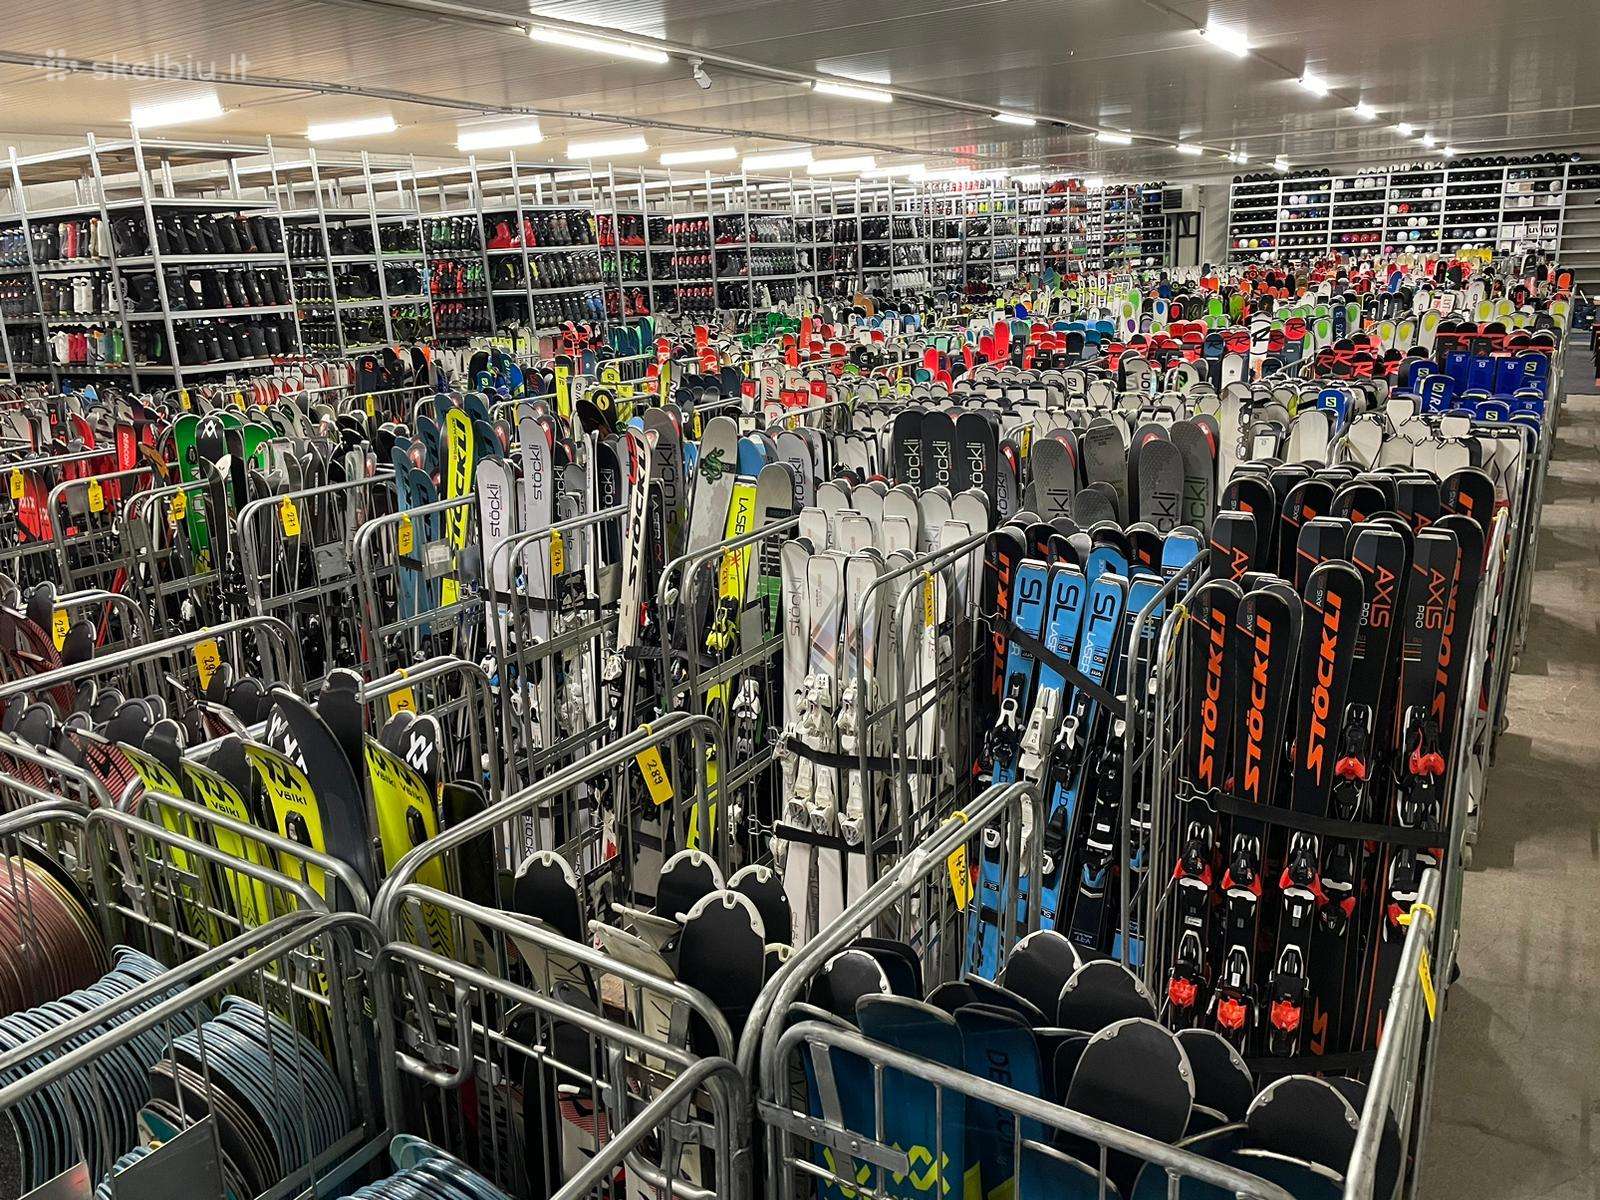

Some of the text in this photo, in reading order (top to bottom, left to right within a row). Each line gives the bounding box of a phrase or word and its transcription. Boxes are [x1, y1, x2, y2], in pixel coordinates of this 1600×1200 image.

[528, 444, 543, 500] stöckli
[487, 484, 502, 538] stöckli
[628, 437, 645, 587] STÖCKLI
[1017, 577, 1042, 616] SL
[1053, 583, 1079, 622] SL
[1089, 592, 1115, 632] SL
[1315, 589, 1324, 608] AXIS
[1360, 565, 1396, 628] AXIS PRO
[1415, 568, 1446, 630] AXIS PRO
[1080, 632, 1097, 674] LASER
[1199, 608, 1226, 790] STÖCKLI
[1244, 615, 1272, 803] STÖCKLI
[1307, 590, 1342, 787] STÖCKLI
[210, 800, 241, 818] Völkl
[276, 787, 308, 806] Völkl
[403, 783, 425, 805] Völkl
